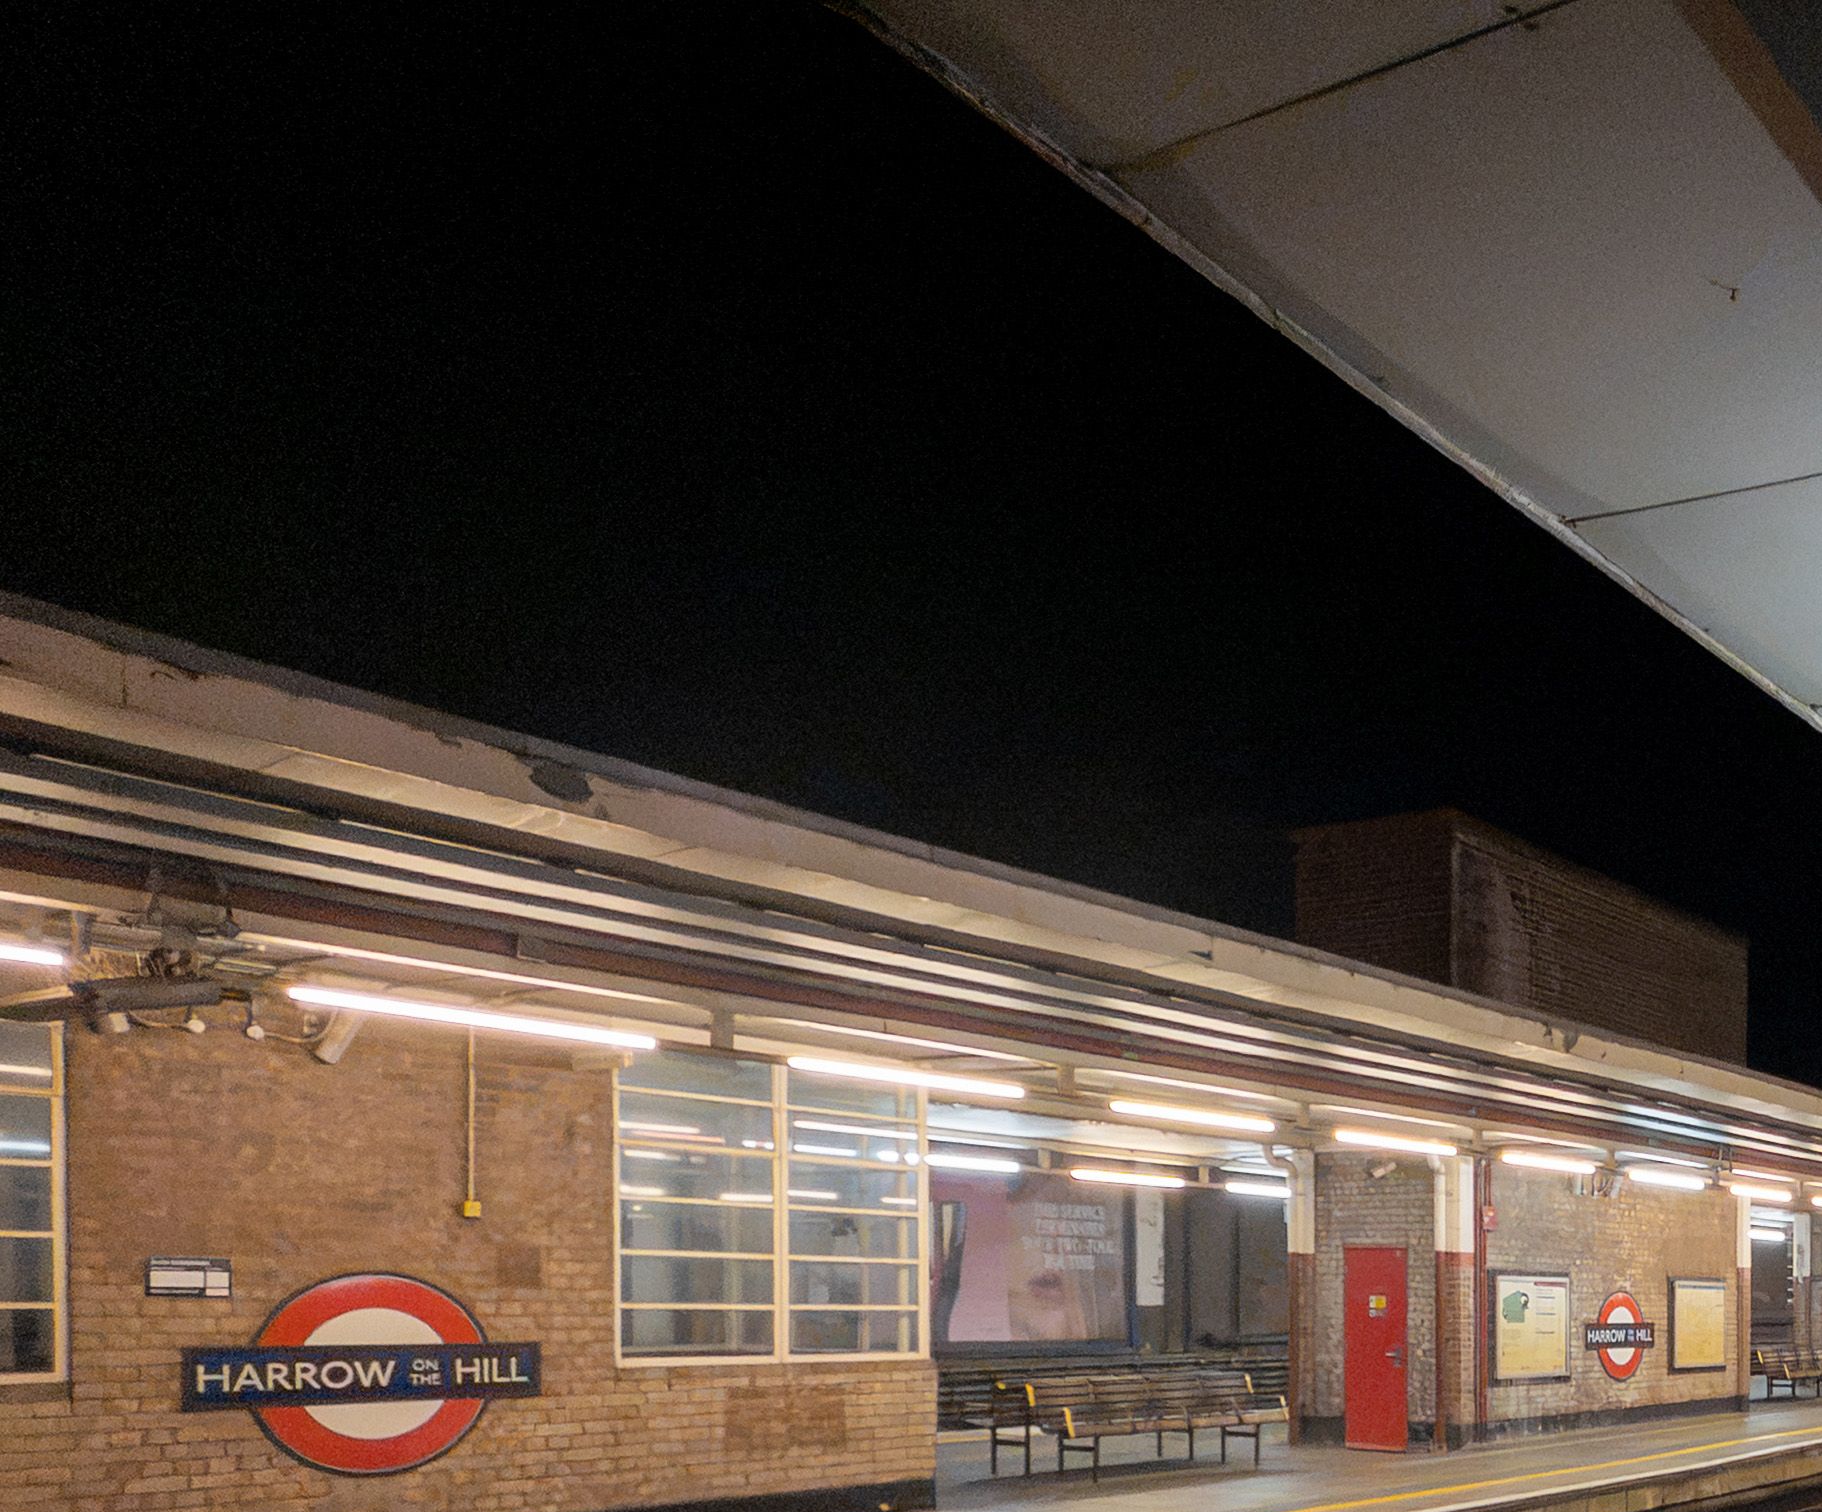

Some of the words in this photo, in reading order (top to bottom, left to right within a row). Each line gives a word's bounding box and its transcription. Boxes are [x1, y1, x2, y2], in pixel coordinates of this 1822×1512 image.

[1587, 1328, 1626, 1343] HARROW
[1635, 1328, 1653, 1342] HILL
[411, 1358, 439, 1372] ON
[454, 1356, 530, 1384] HILL
[196, 1359, 396, 1393] HARROW
[410, 1373, 441, 1386] THE
